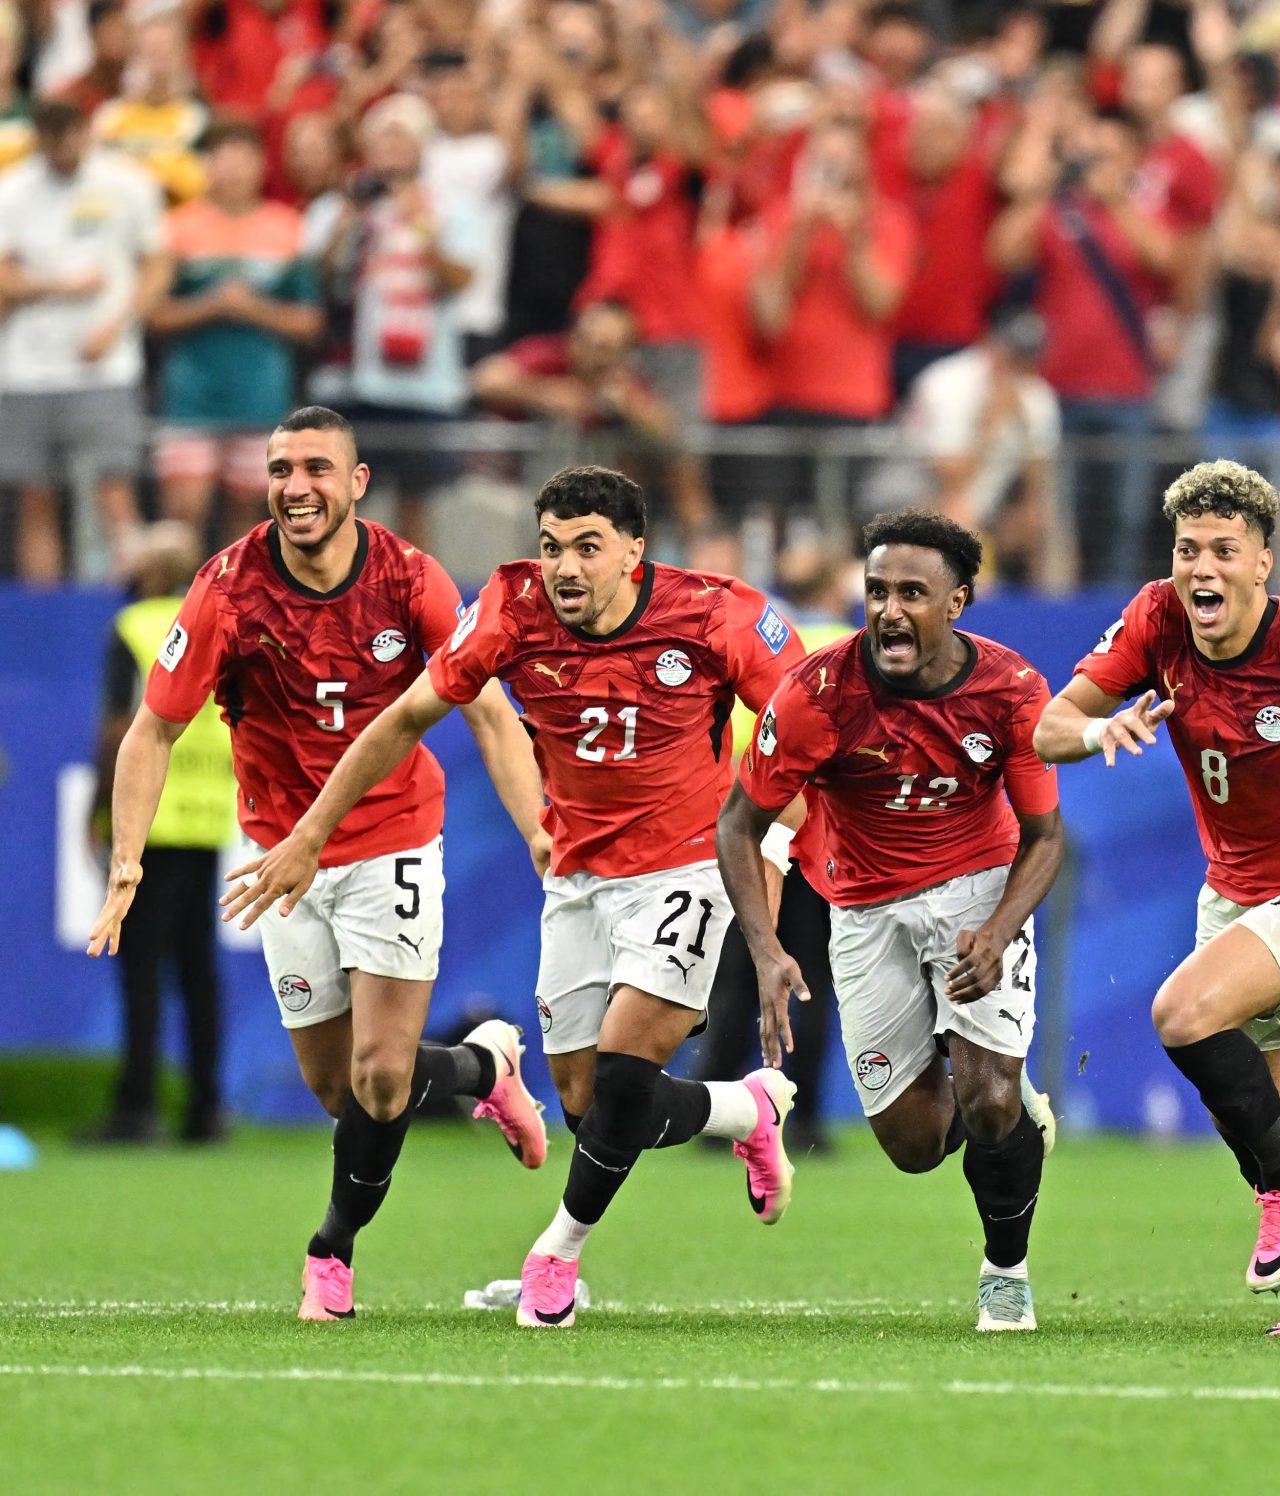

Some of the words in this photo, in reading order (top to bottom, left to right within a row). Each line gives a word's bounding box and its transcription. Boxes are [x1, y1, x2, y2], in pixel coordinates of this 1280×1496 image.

[316, 681, 348, 732] 5
[576, 706, 640, 763] 21
[885, 774, 959, 811] 12
[1201, 748, 1229, 805] 8
[395, 857, 422, 920] 5
[653, 890, 714, 960] 21
